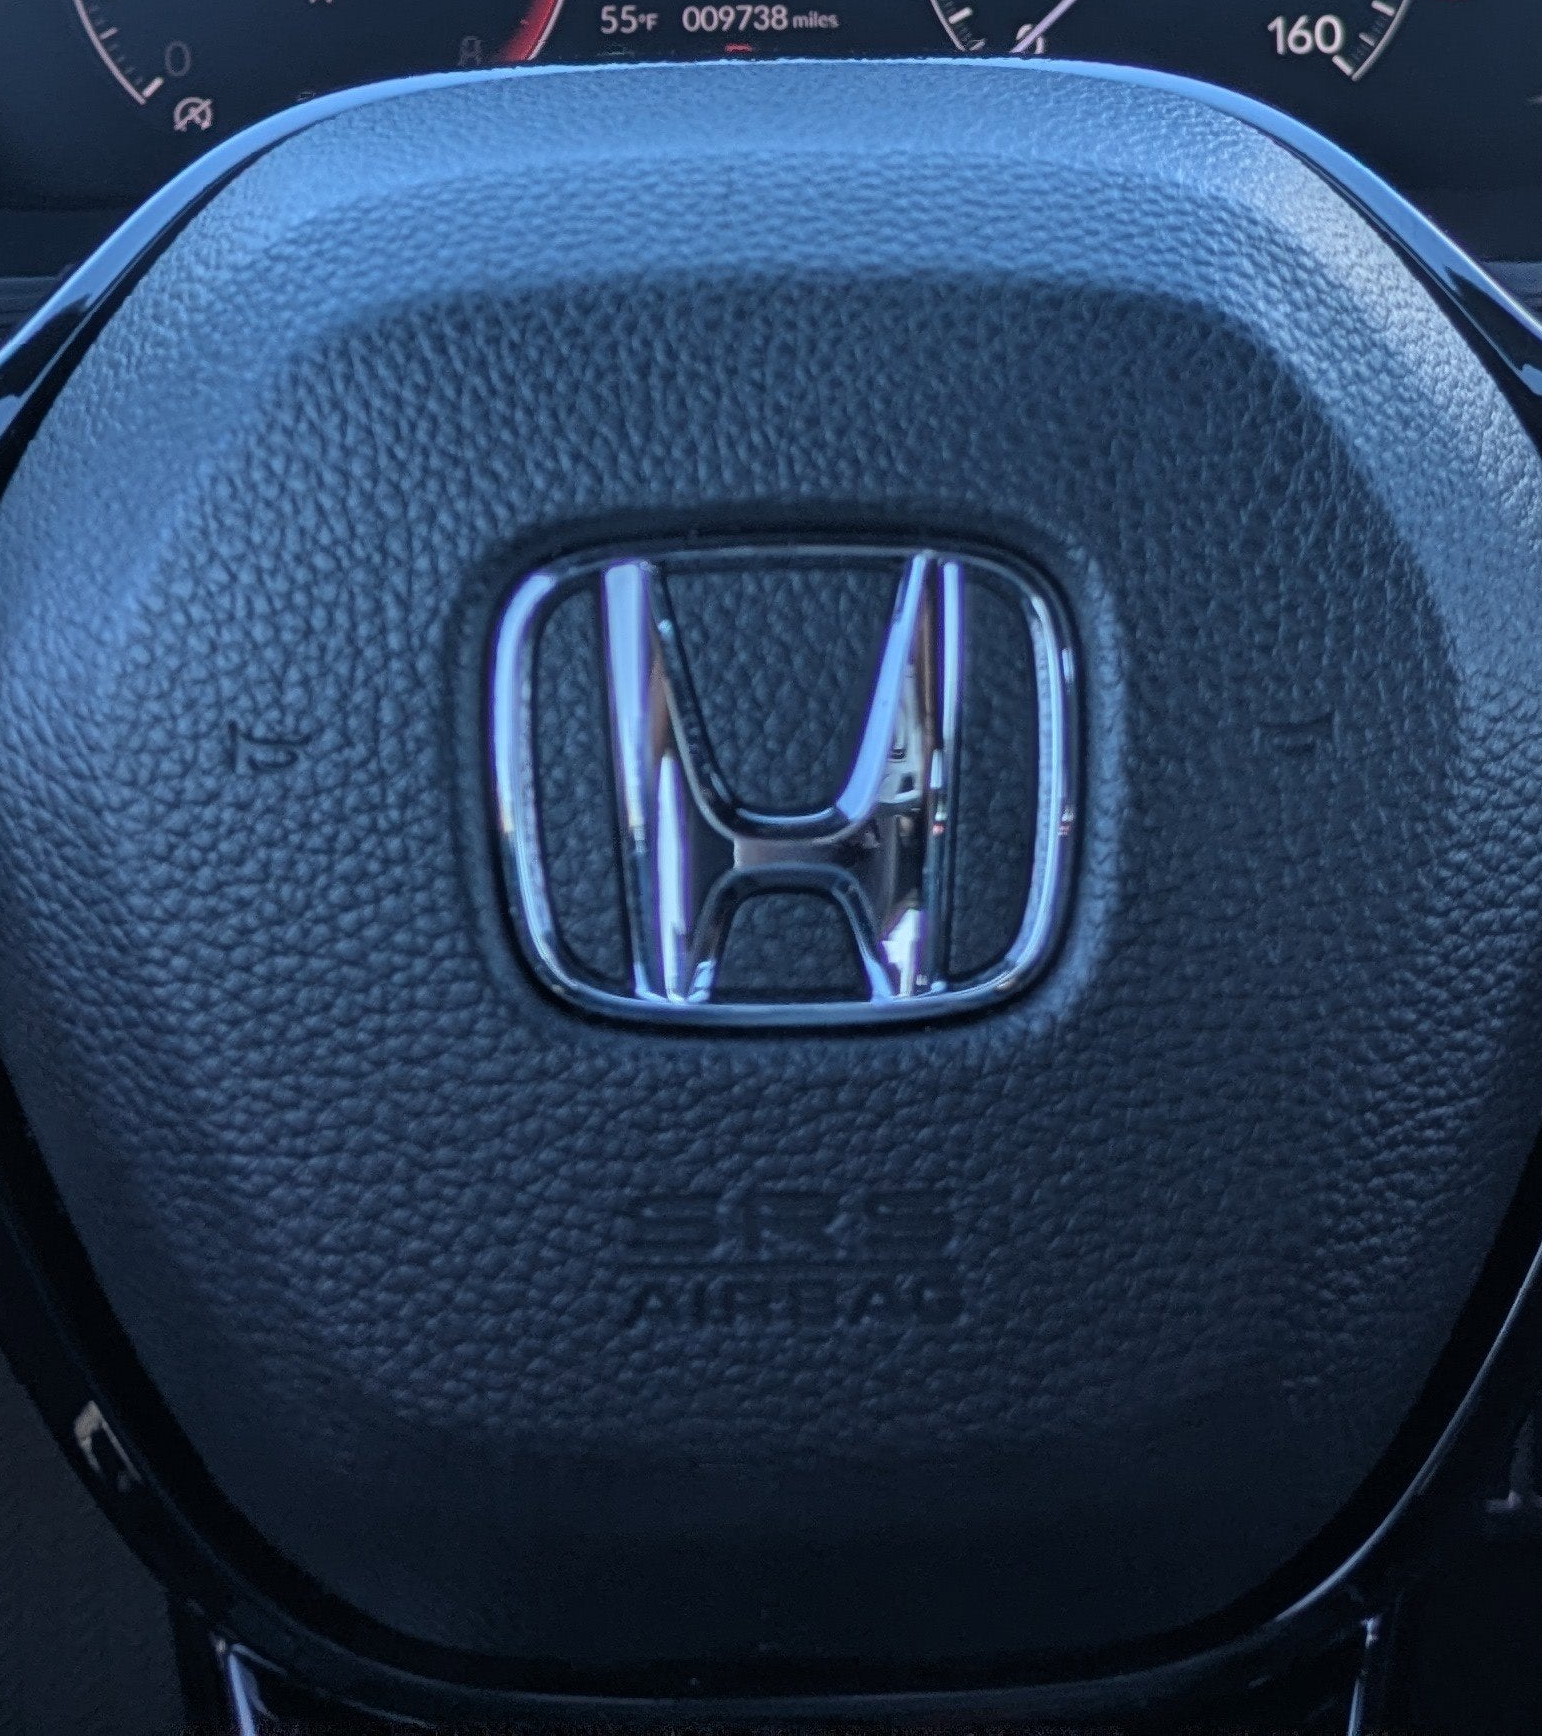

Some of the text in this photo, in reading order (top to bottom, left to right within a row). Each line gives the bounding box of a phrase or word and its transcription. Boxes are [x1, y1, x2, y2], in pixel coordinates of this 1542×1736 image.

[682, 5, 839, 33] 009738 miles
[1267, 15, 1345, 55] 160
[164, 42, 191, 77] 0
[622, 1188, 956, 1254] SRS
[620, 1279, 965, 1328] AIRBAG
